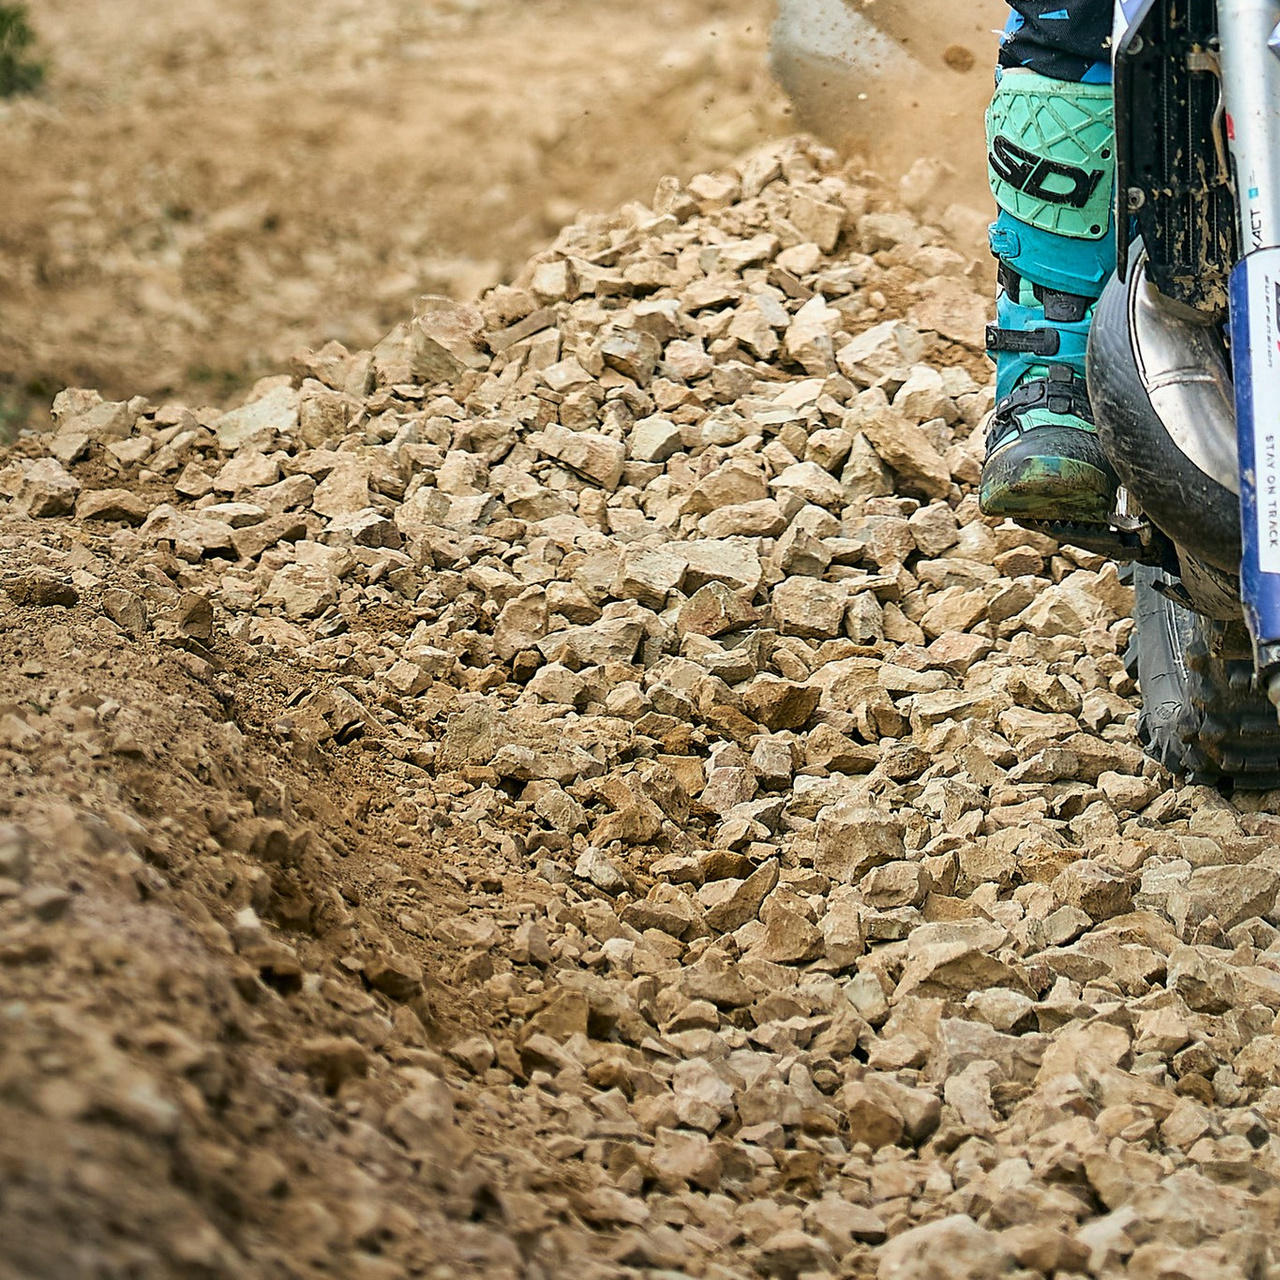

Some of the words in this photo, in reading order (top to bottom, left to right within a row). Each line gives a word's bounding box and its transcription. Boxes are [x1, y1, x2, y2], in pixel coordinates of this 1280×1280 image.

[1264, 434, 1276, 466] STAY
[1266, 475, 1277, 493] ON
[1267, 497, 1279, 548] TRACK
